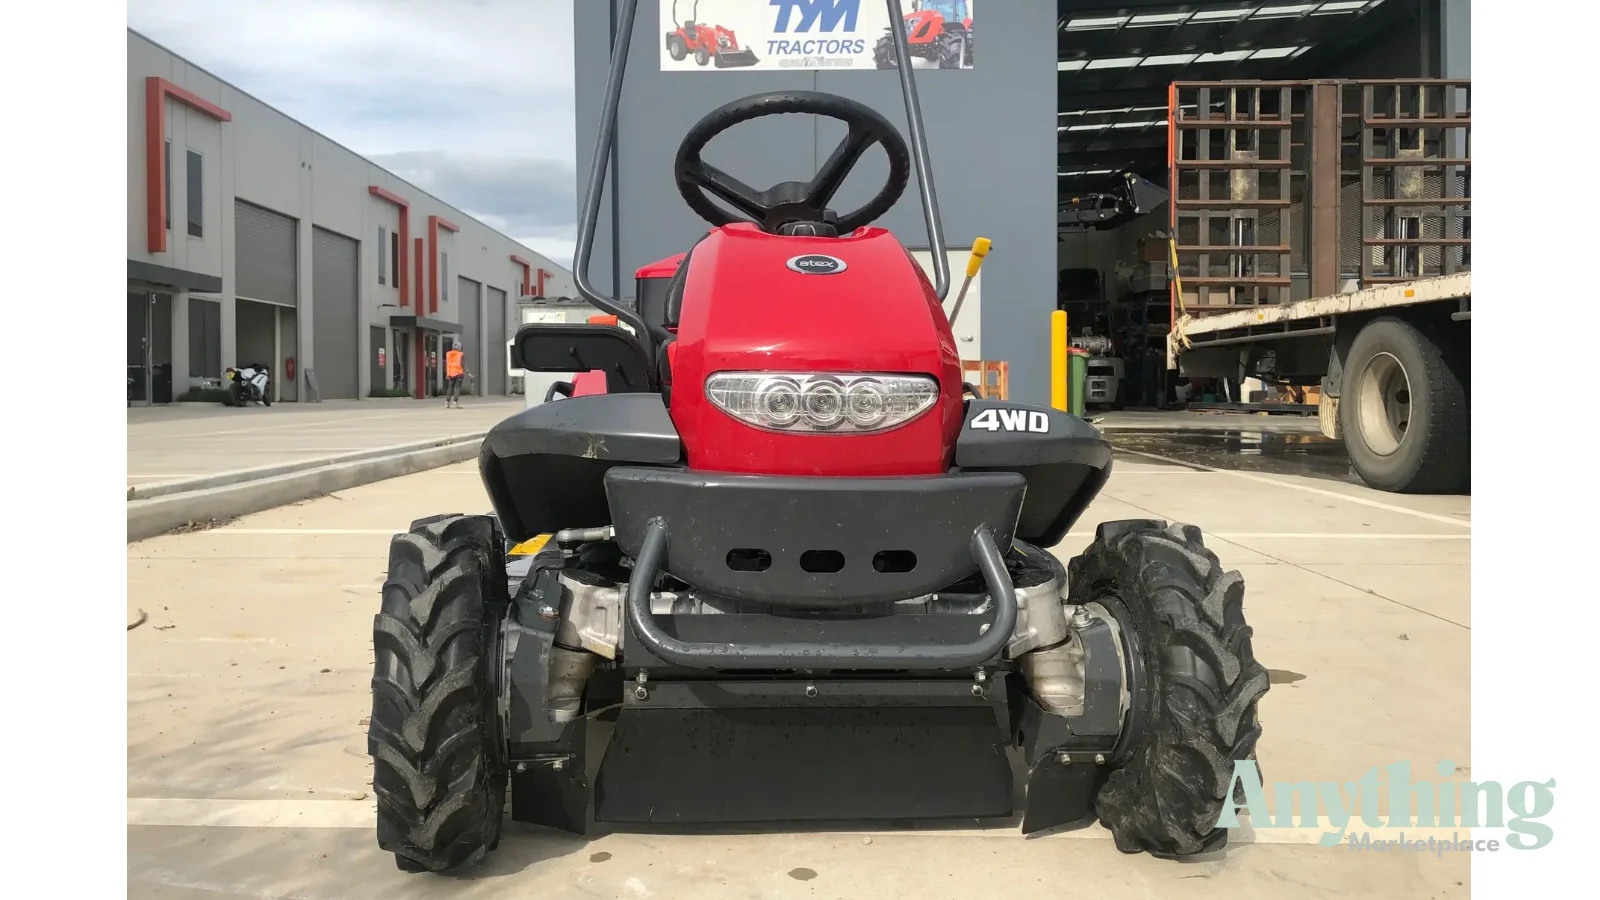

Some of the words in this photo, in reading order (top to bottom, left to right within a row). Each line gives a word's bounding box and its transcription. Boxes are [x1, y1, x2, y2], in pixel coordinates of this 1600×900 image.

[768, 0, 861, 33] TYM
[767, 39, 865, 55] TRACTORS
[799, 259, 834, 268] atex
[970, 409, 1050, 433] 4WD
